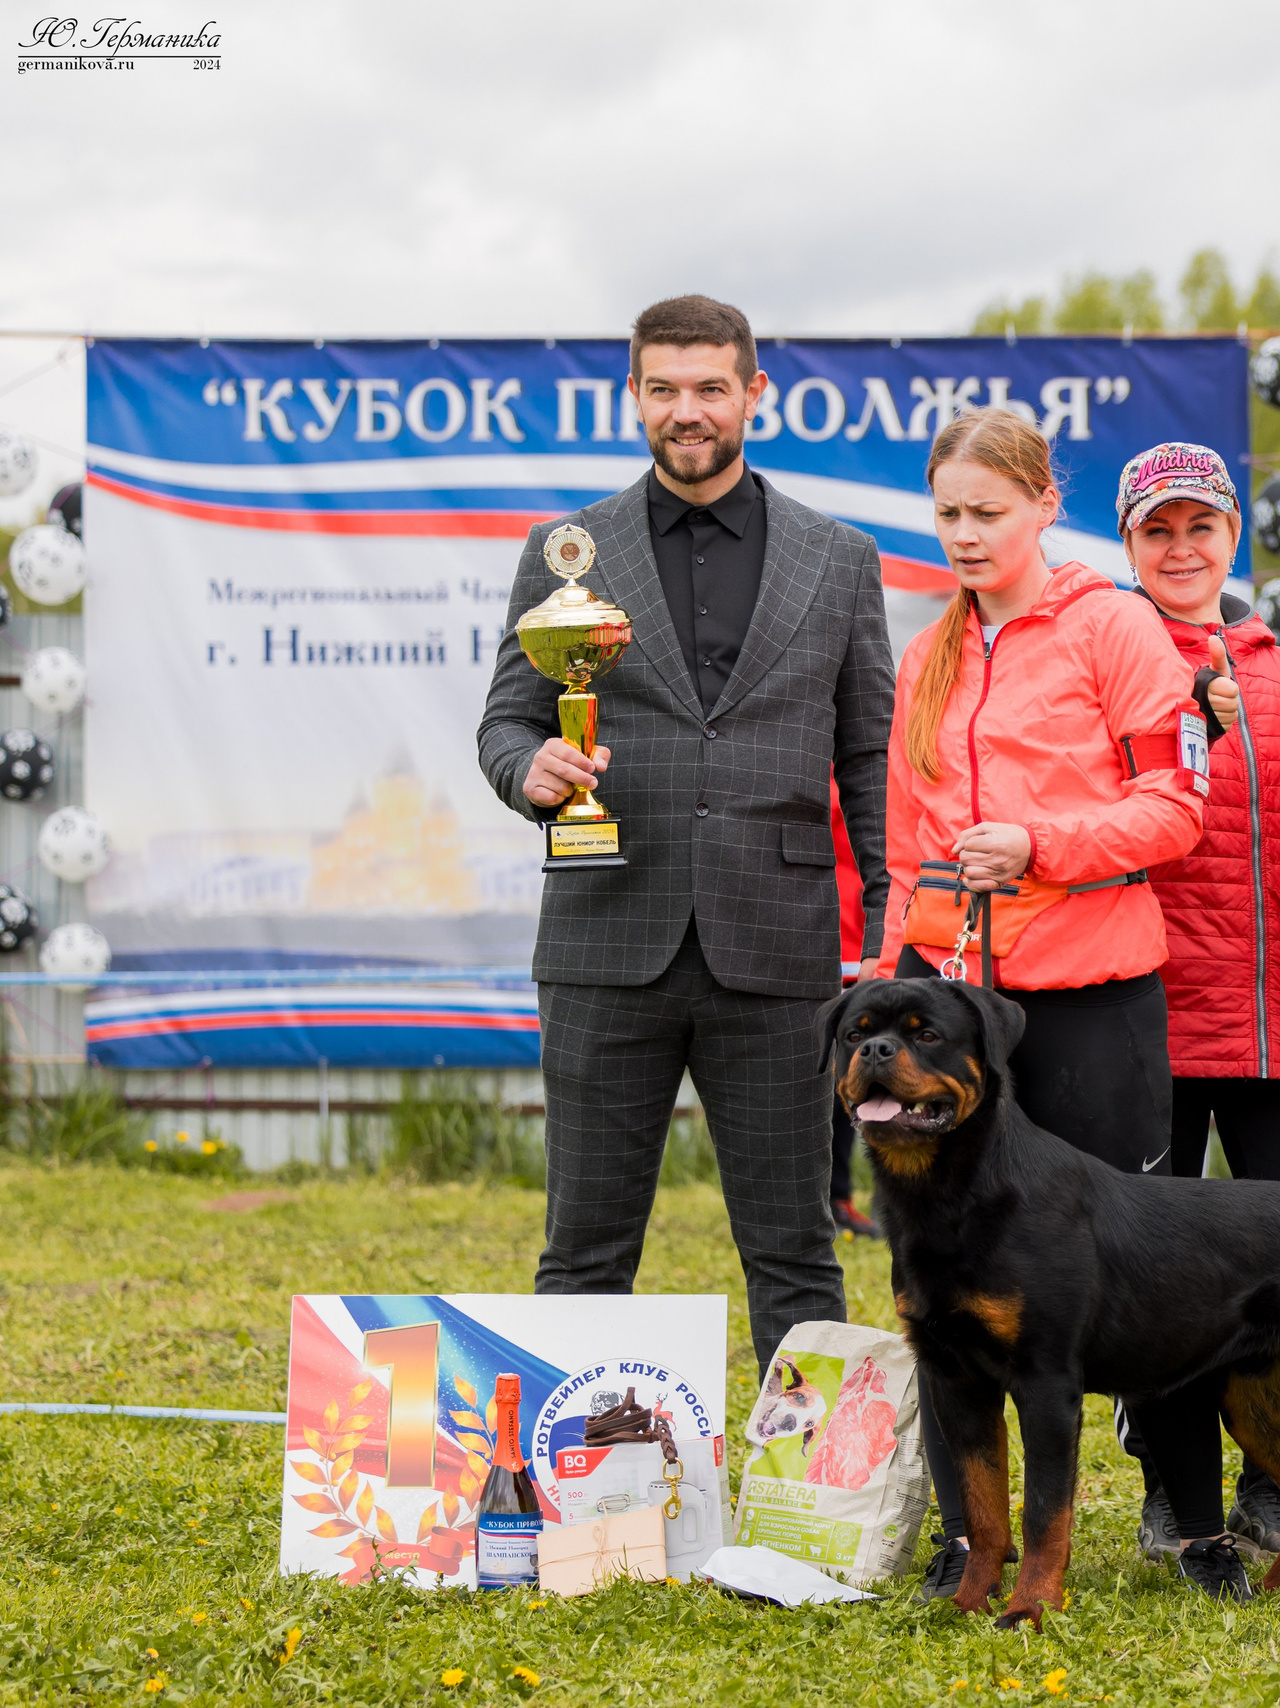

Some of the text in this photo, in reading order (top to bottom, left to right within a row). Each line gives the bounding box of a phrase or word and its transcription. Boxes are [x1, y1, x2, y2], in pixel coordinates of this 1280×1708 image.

[263, 626, 446, 666] Нижний
[363, 1320, 441, 1490] 1
[536, 1365, 607, 1458] РОТВЕЙЛЕР
[619, 1362, 669, 1383] КЛУБ
[564, 1454, 587, 1469] BQ
[567, 1491, 583, 1499] 500
[770, 1498, 802, 1508] BALANCE
[770, 1523, 801, 1532] ВЗРОСЛЫХ
[801, 1527, 821, 1535] СОБАК
[814, 1522, 831, 1530] КОРМ
[757, 1528, 802, 1540] КРУПНЫХ ПОРОД
[761, 1540, 802, 1552] ЯГНЕНКОМ
[836, 1552, 842, 1560] 3
